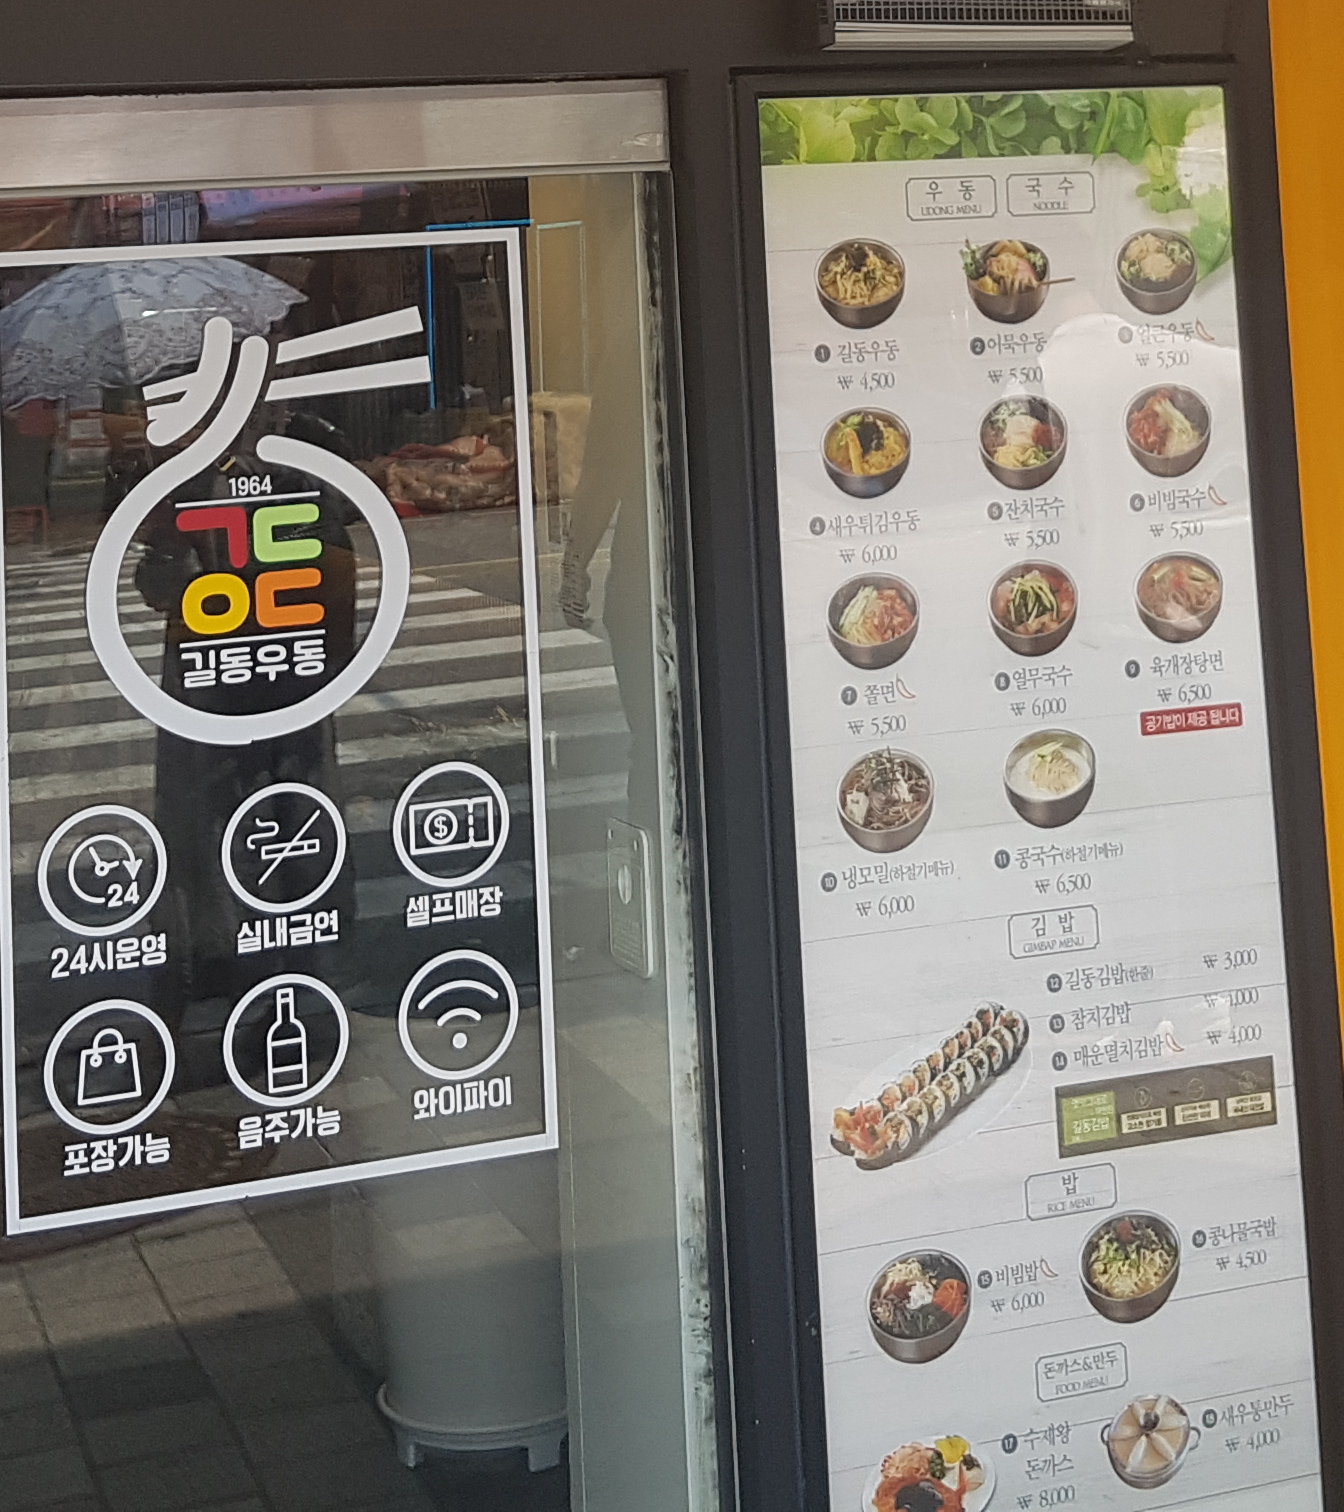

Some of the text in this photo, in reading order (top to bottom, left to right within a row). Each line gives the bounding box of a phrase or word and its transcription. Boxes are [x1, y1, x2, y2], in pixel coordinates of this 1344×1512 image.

[837, 339, 899, 364] 길동우동
[1156, 351, 1189, 368] 5,500
[860, 372, 895, 392] 4,500
[1009, 366, 1043, 384] 5,500
[228, 474, 272, 497] 1964
[1006, 496, 1065, 521] 잔치국수
[1148, 488, 1206, 511] 비빔국수
[827, 509, 921, 537] 새우튀김우동
[1170, 521, 1203, 540] 5,500
[1026, 529, 1060, 549] 5,500
[862, 545, 897, 565] 6,000
[181, 640, 326, 688] 길동우동
[1150, 651, 1224, 677] 육개장탕면
[1012, 665, 1073, 690] 열무국수
[864, 681, 896, 706] 쫄면
[1178, 684, 1212, 704] 6,500
[1032, 698, 1066, 718] 6,000
[1145, 707, 1240, 732] 공기밥이 제공 됩니다
[871, 715, 906, 737] 5,500
[106, 881, 140, 908] 24
[1056, 873, 1092, 894] 6,500
[405, 887, 504, 928] 셀프매장
[878, 895, 915, 918] 6,000
[237, 910, 340, 955] 실내금연
[50, 934, 168, 979] 24시운영
[1224, 948, 1258, 970] 3,000
[1070, 1002, 1132, 1031] 참치김밥
[1073, 1033, 1163, 1068] 매운멸치김밥
[413, 1078, 513, 1121] 와이파이
[238, 1106, 342, 1149] 음주가능
[62, 1133, 171, 1179] 포장가능
[1061, 1172, 1078, 1194] 밥
[1207, 1217, 1277, 1248] 콩나물국밥
[1234, 1249, 1267, 1269] 4,500
[995, 1263, 1040, 1286] 비빔밥
[1010, 1291, 1044, 1313] 6,000
[1042, 1350, 1120, 1380] 돈까스&만두
[1245, 1429, 1280, 1451] 4,000
[1025, 1454, 1074, 1479] 돈까스
[1038, 1486, 1075, 1508] 8,000
